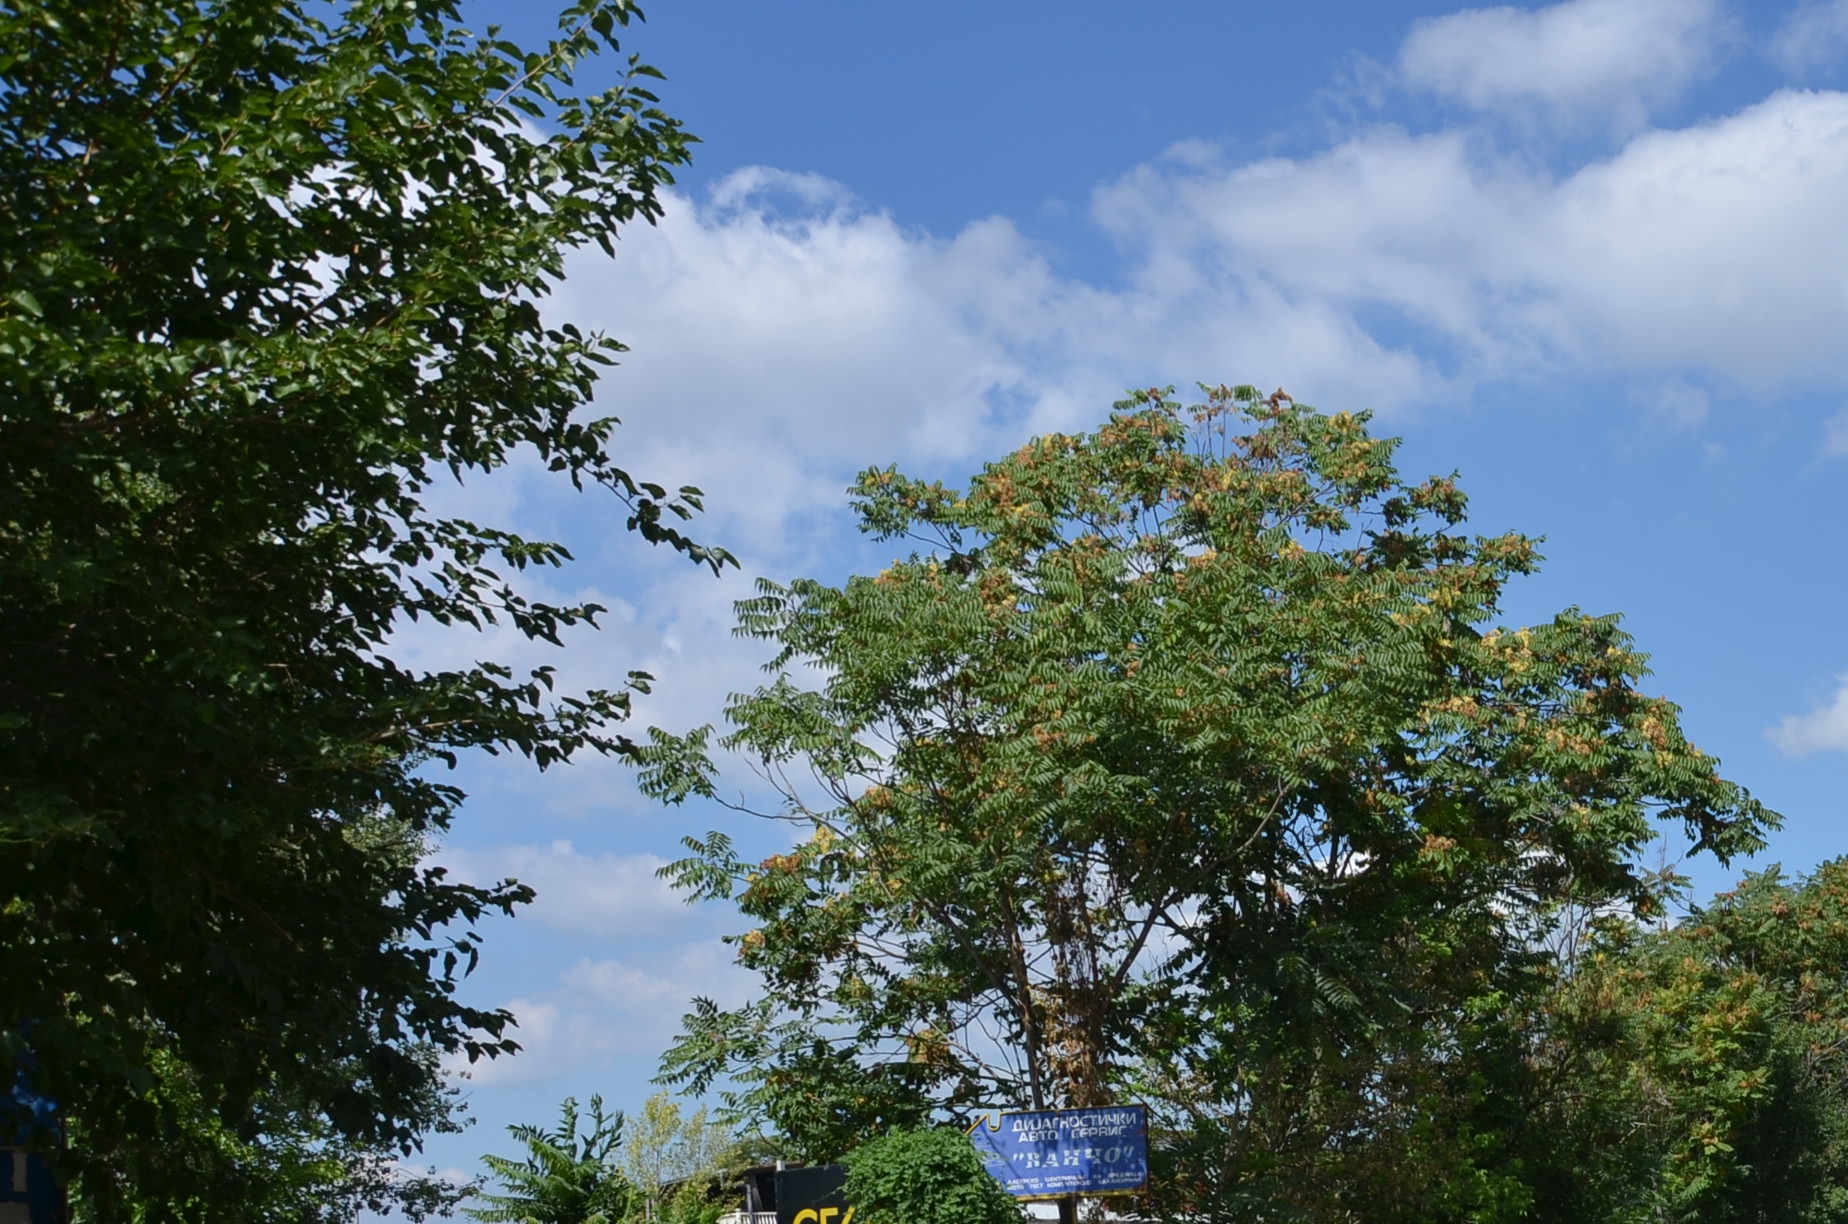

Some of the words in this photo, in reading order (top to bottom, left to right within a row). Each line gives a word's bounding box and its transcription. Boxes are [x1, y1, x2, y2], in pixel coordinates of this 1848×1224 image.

[1011, 1112, 1137, 1133] ДИЈАГНОСТИЧКИ
[1018, 1130, 1059, 1143] АВТО
[1071, 1125, 1130, 1139] СЕРВИС
